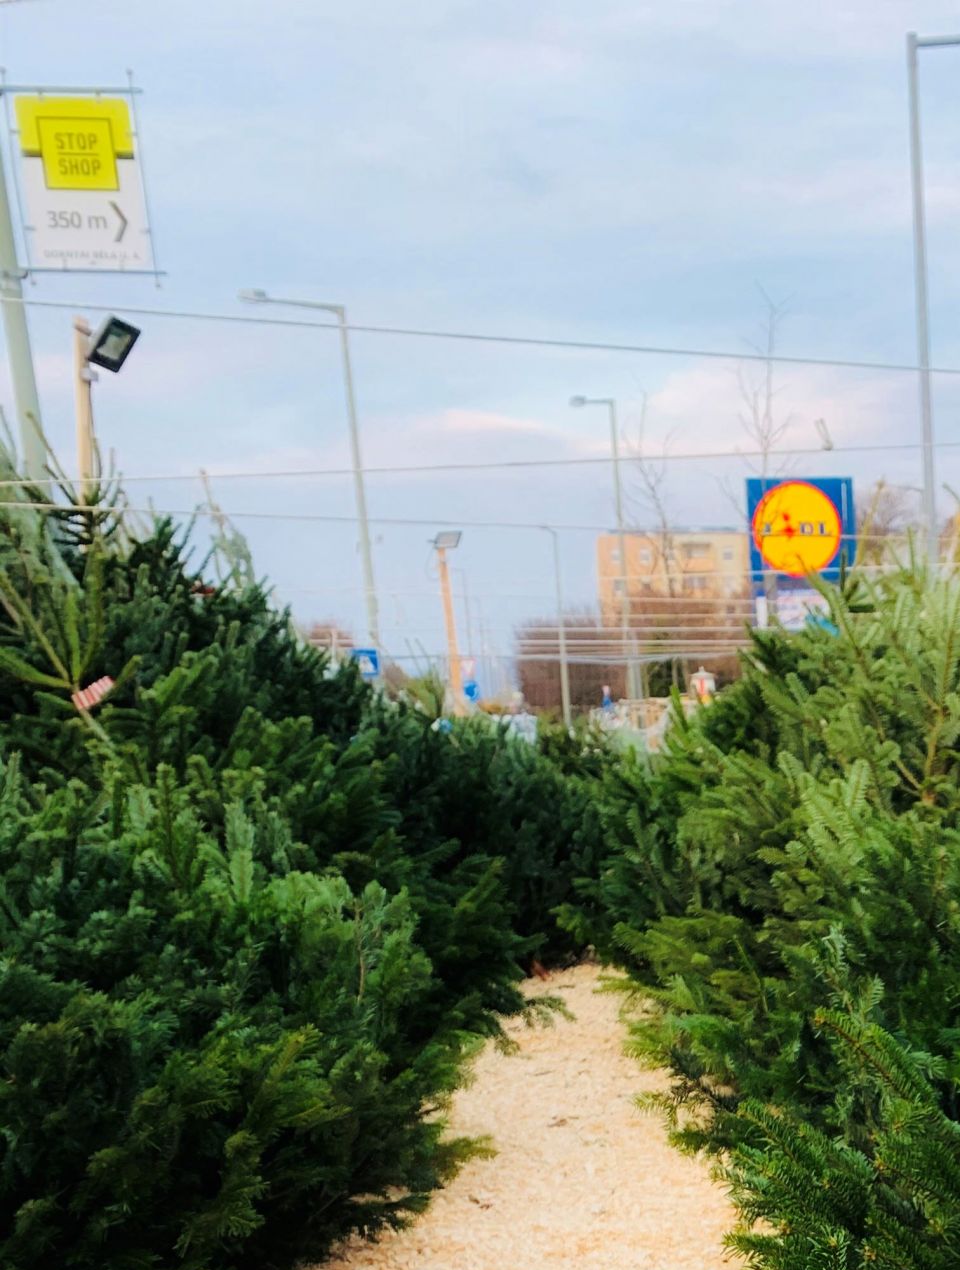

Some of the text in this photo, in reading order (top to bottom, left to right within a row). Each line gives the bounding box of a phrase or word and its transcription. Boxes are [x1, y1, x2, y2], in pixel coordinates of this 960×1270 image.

[54, 132, 98, 150] STOP
[58, 158, 101, 175] SHOP
[46, 210, 108, 229] 350 m
